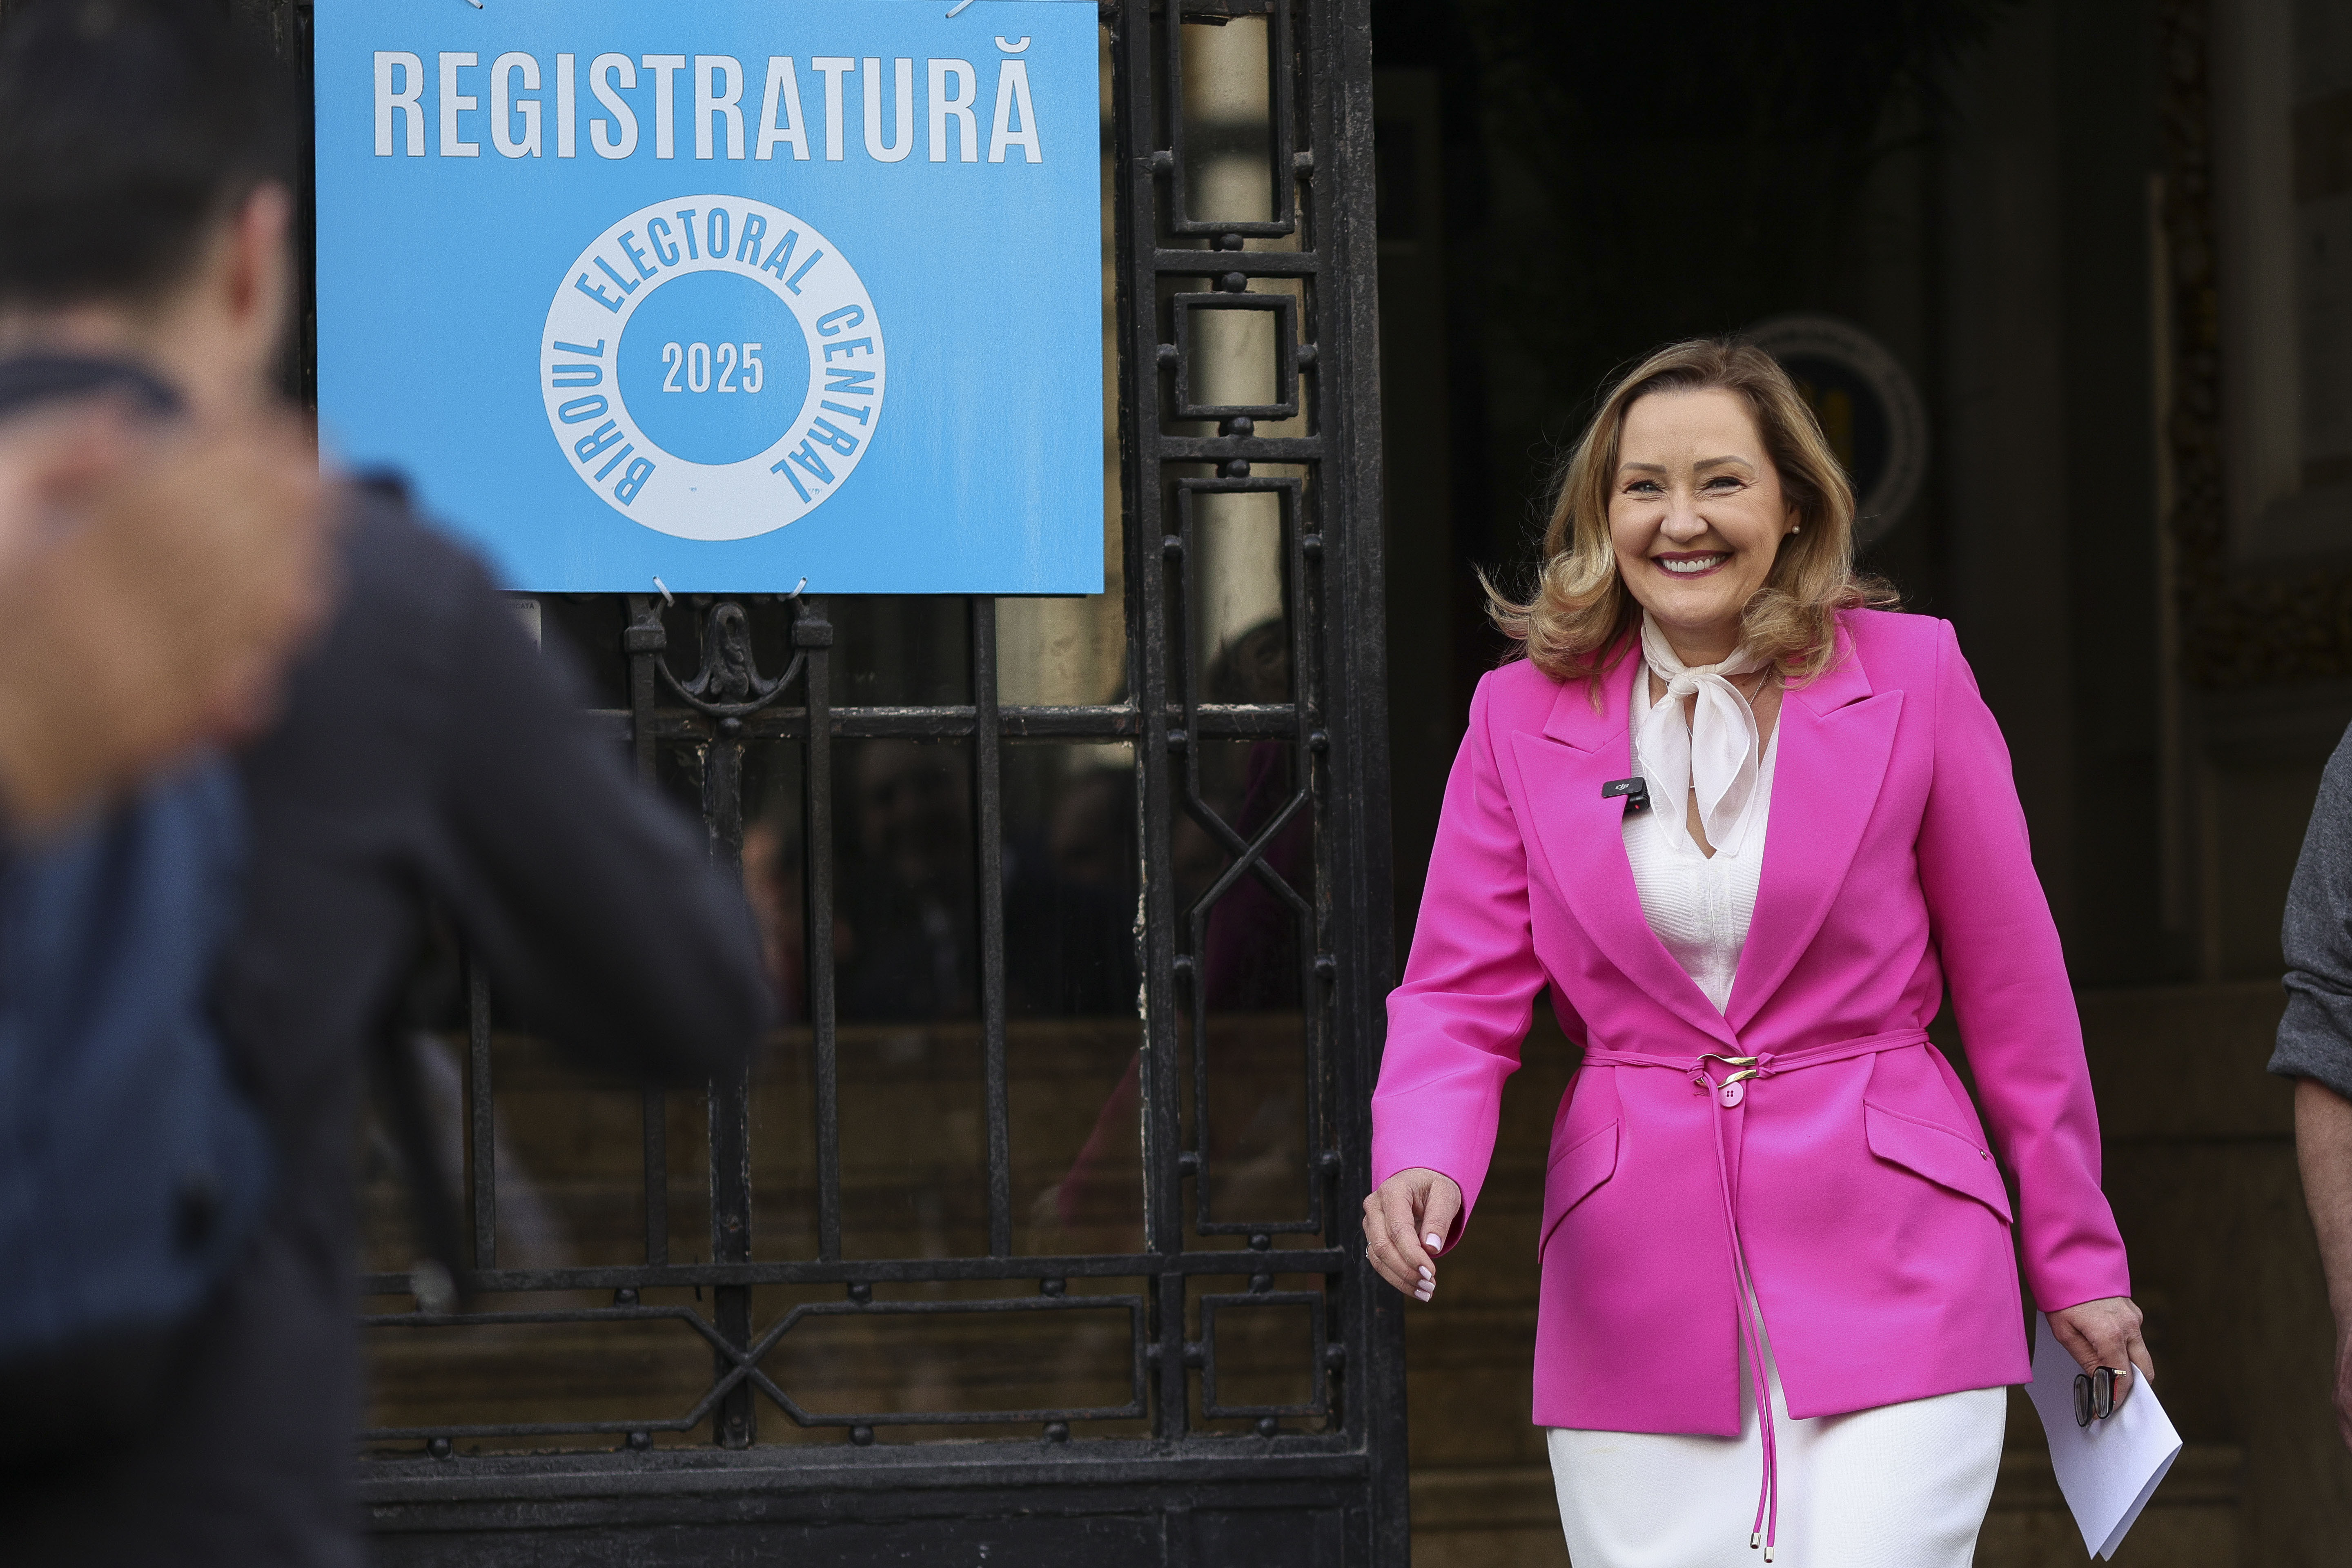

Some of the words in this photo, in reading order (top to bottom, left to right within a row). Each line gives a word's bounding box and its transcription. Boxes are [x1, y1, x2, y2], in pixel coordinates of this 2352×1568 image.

[374, 36, 1043, 163] REGISTRATURĂ
[574, 207, 824, 314] ELECTORAL
[552, 339, 656, 507] BIROUL
[662, 342, 764, 393] 2025
[770, 304, 875, 504] CENTRAL
